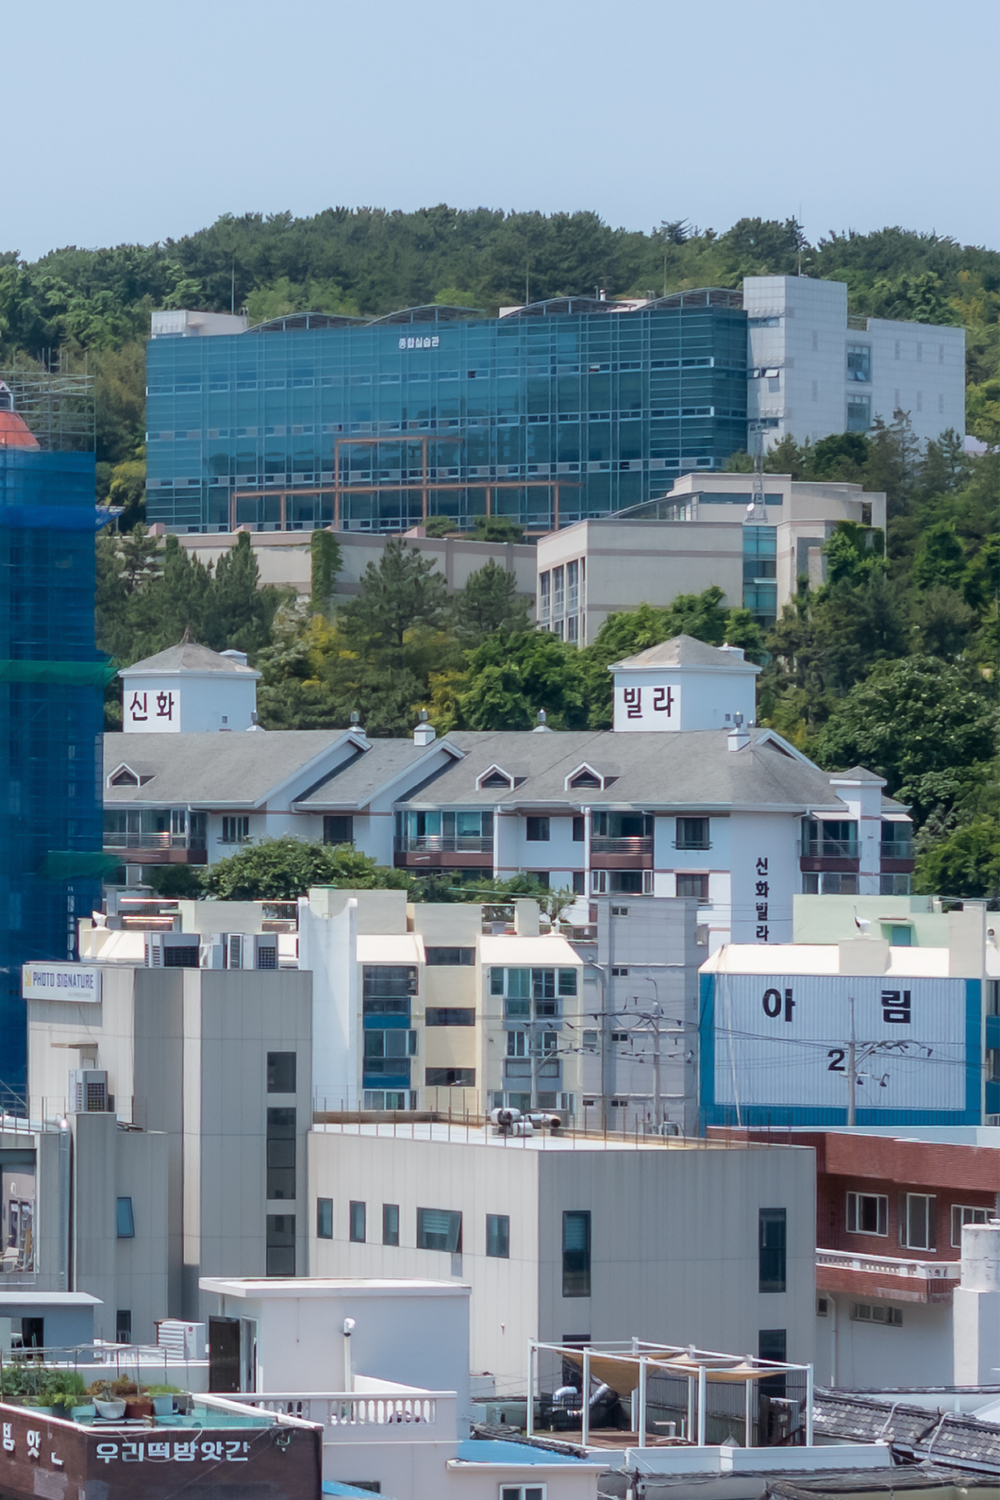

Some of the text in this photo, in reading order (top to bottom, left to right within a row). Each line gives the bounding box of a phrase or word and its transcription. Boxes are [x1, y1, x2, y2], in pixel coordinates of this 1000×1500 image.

[130, 691, 174, 721] 신화
[624, 686, 675, 719] 빌라
[755, 857, 770, 942] 신화빌라
[33, 971, 94, 990] PHOTO SIGNATURE
[827, 1049, 846, 1072] 2
[96, 1441, 252, 1464] 우리떡방앗간
